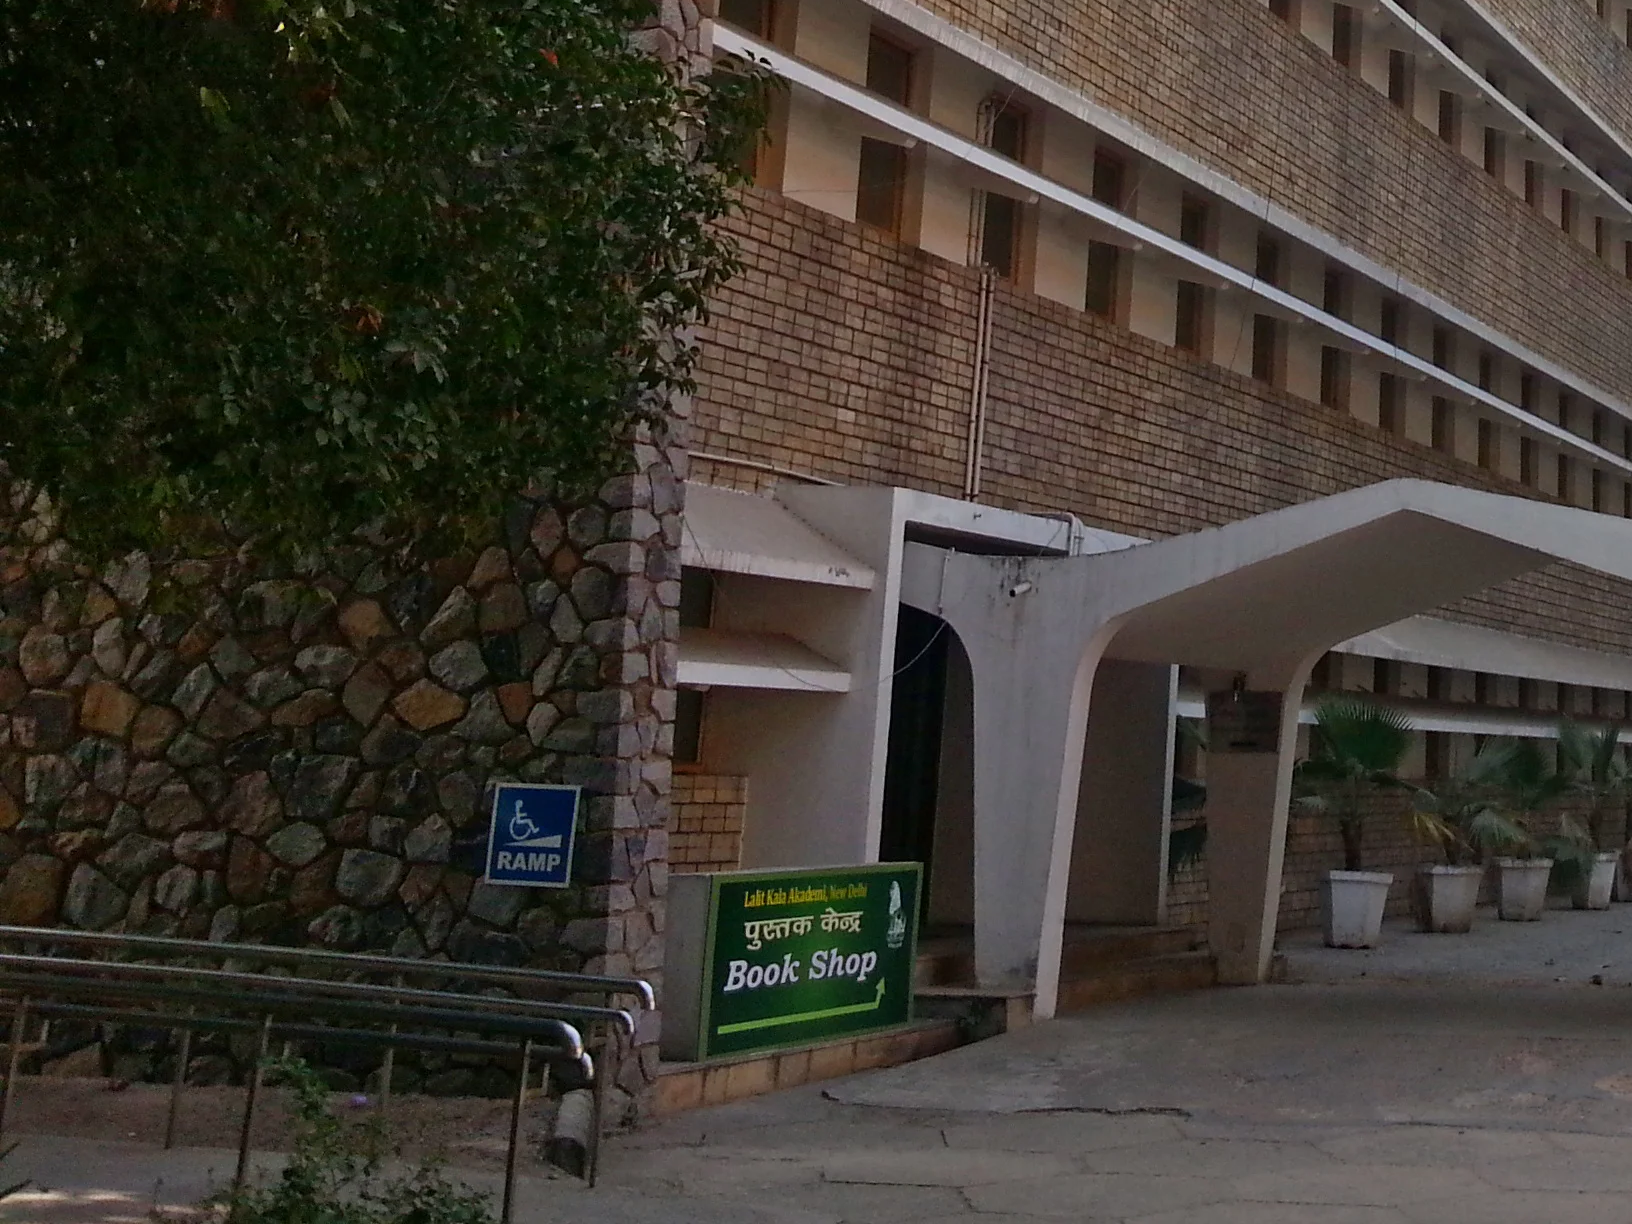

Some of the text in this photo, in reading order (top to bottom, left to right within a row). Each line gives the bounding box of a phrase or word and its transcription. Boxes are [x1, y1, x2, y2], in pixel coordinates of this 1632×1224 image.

[497, 851, 561, 872] RAMP
[744, 890, 765, 907] Lalit
[766, 888, 787, 905] Kala
[830, 885, 847, 900] New
[848, 883, 868, 898] Delhi
[744, 907, 864, 950] पुस्तक केन्द्र
[723, 947, 877, 991] Book Shop
